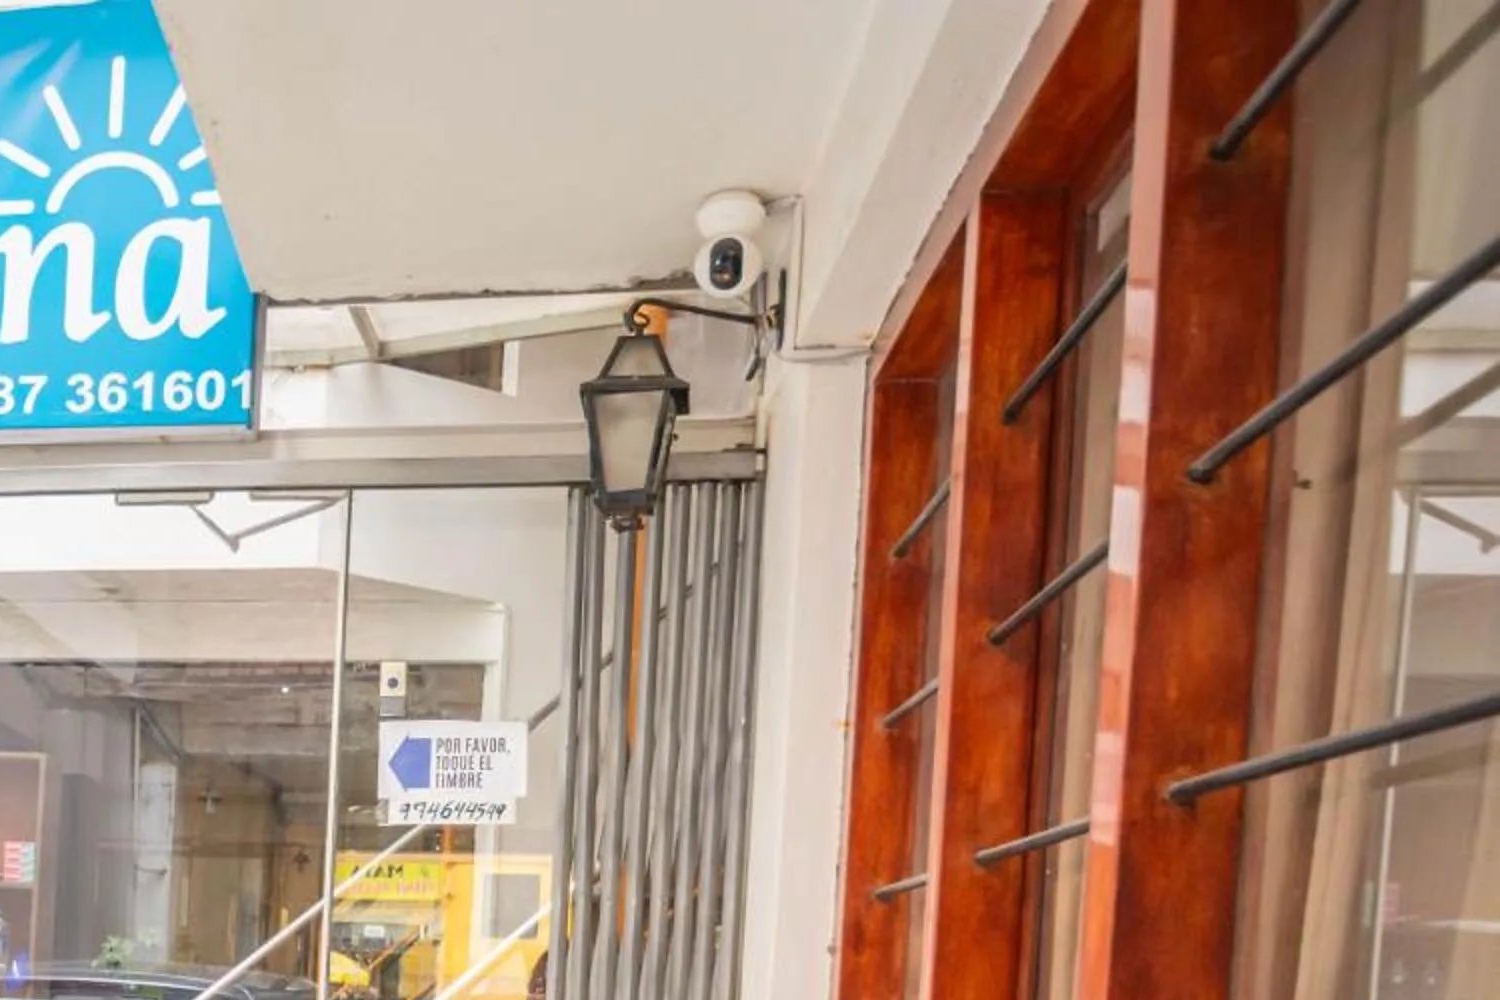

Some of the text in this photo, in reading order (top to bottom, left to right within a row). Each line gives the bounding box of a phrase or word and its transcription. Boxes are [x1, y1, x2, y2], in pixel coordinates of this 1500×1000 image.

[65, 369, 252, 414] 361601
[435, 737, 512, 755] POR FAVOR,
[435, 755, 494, 771] TOQUE EL
[435, 772, 483, 789] TIMBRE
